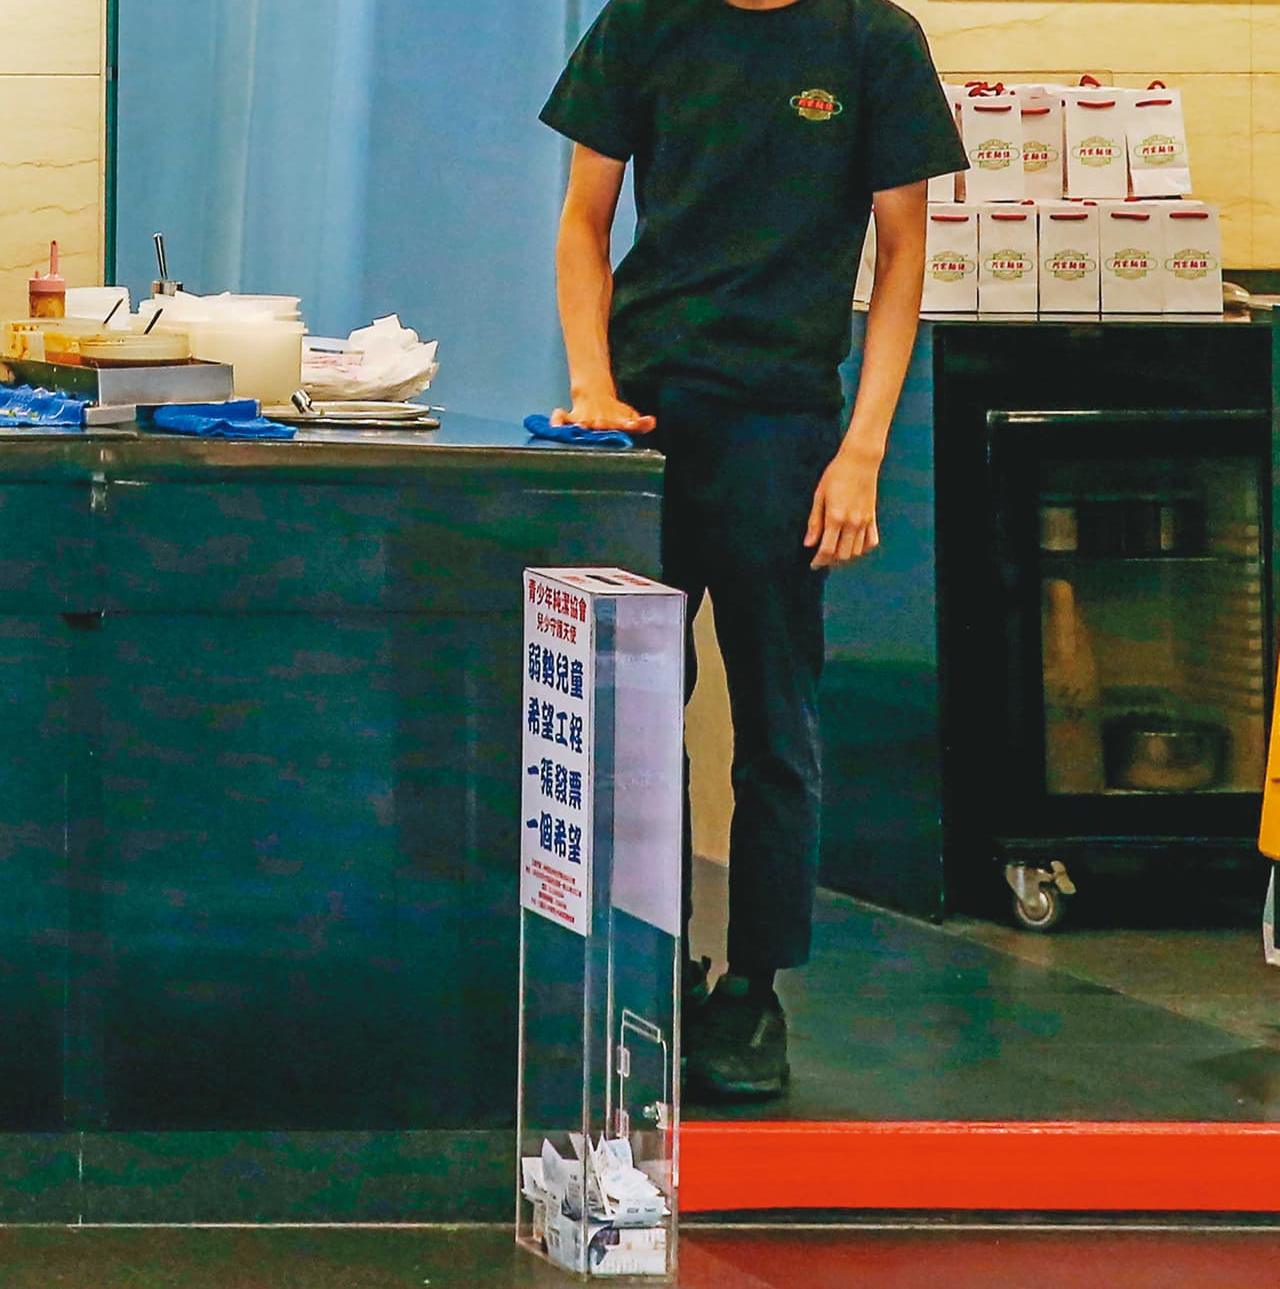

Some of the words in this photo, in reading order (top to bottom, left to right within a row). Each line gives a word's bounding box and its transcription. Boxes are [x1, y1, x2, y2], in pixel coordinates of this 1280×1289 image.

[528, 642, 584, 700] 弱勢兒童
[528, 697, 583, 753] 希望工程
[527, 757, 582, 810] 一張發票
[526, 810, 581, 864] 一個希望
